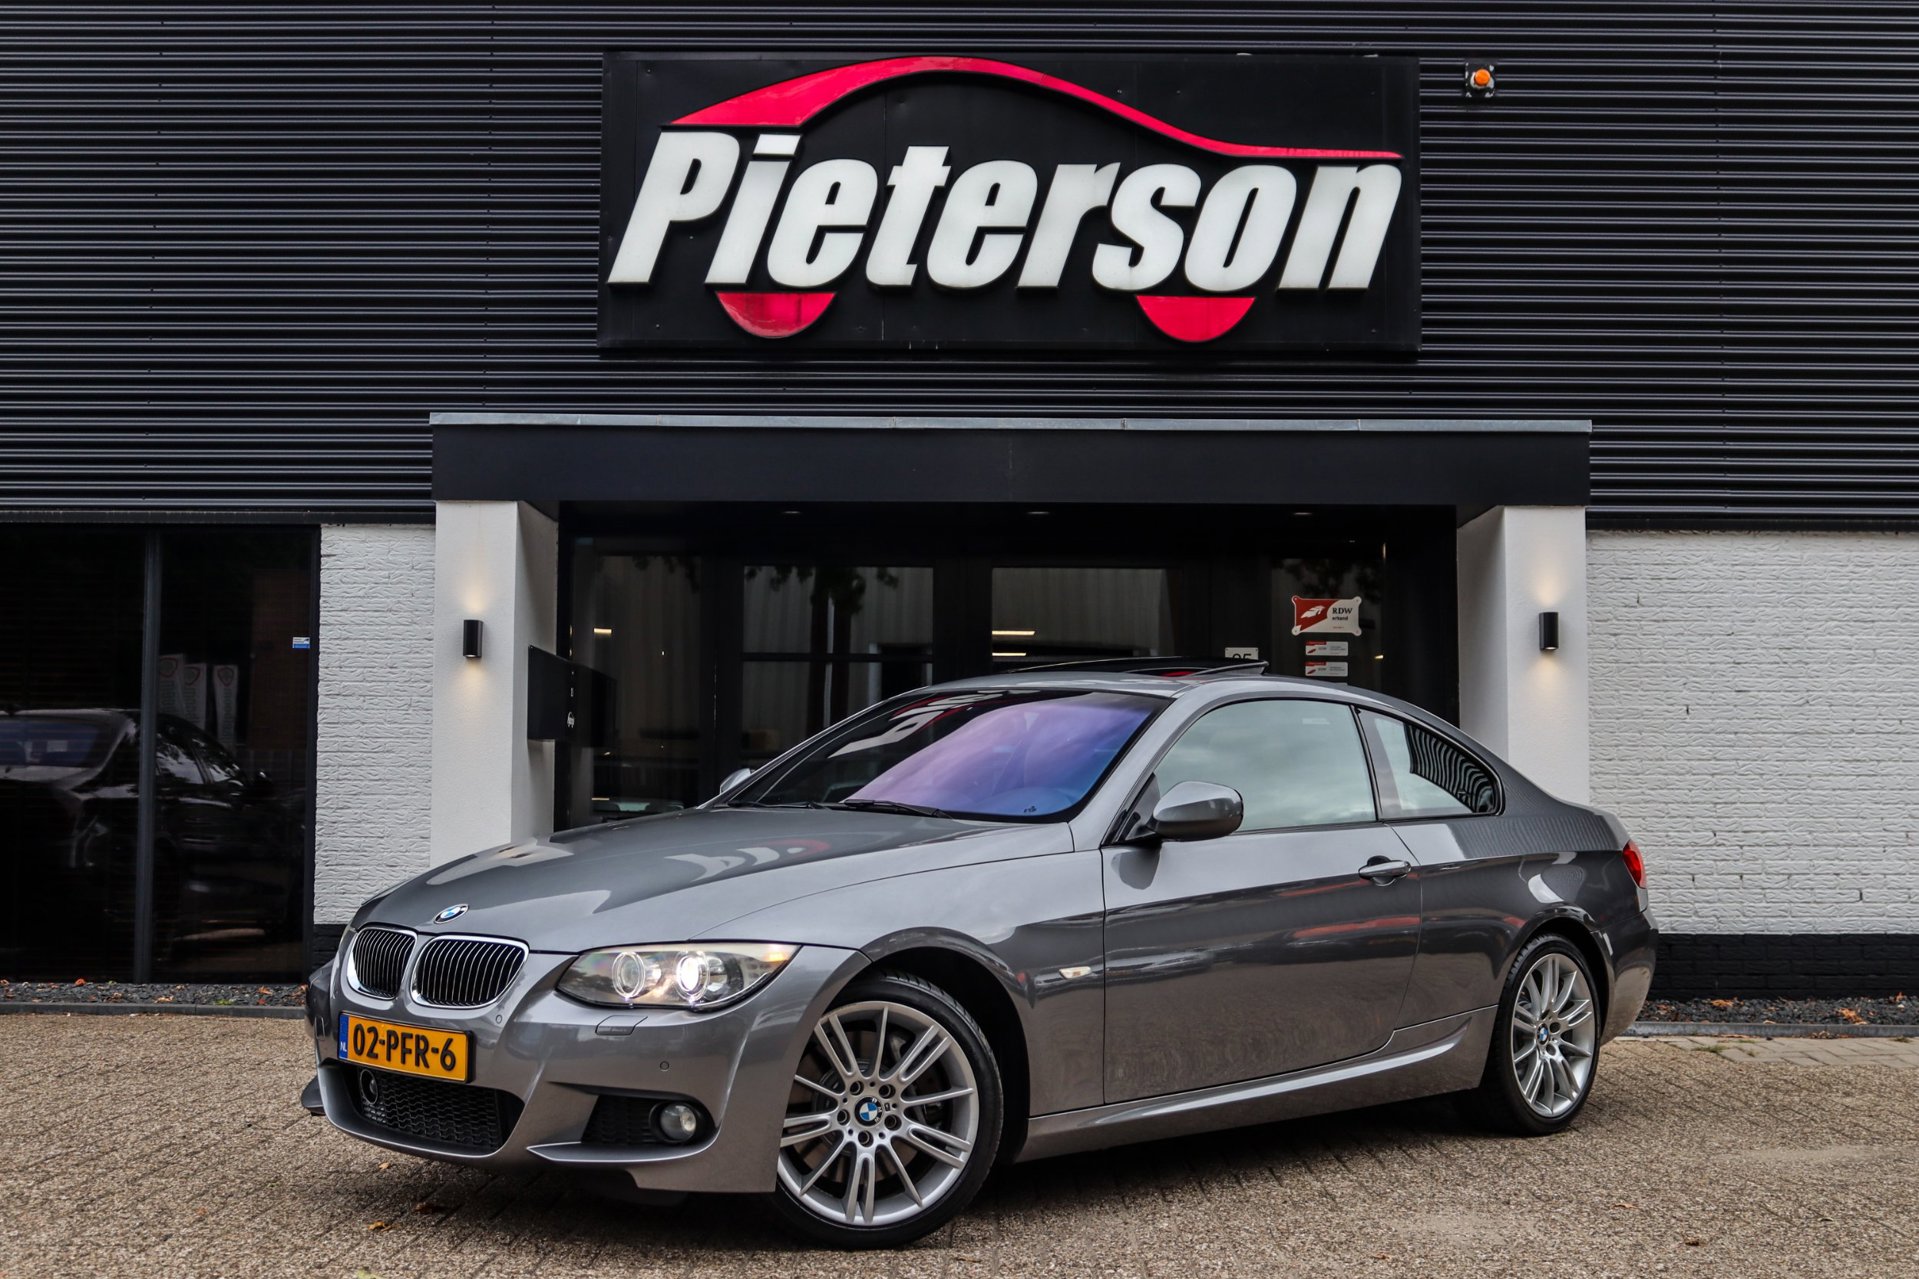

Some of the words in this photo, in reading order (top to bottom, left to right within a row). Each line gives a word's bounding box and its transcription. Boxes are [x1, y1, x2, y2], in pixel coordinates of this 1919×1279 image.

[607, 130, 1402, 292] Pieterson
[340, 1041, 347, 1052] NL
[353, 1023, 457, 1072] 02-PFR-6
